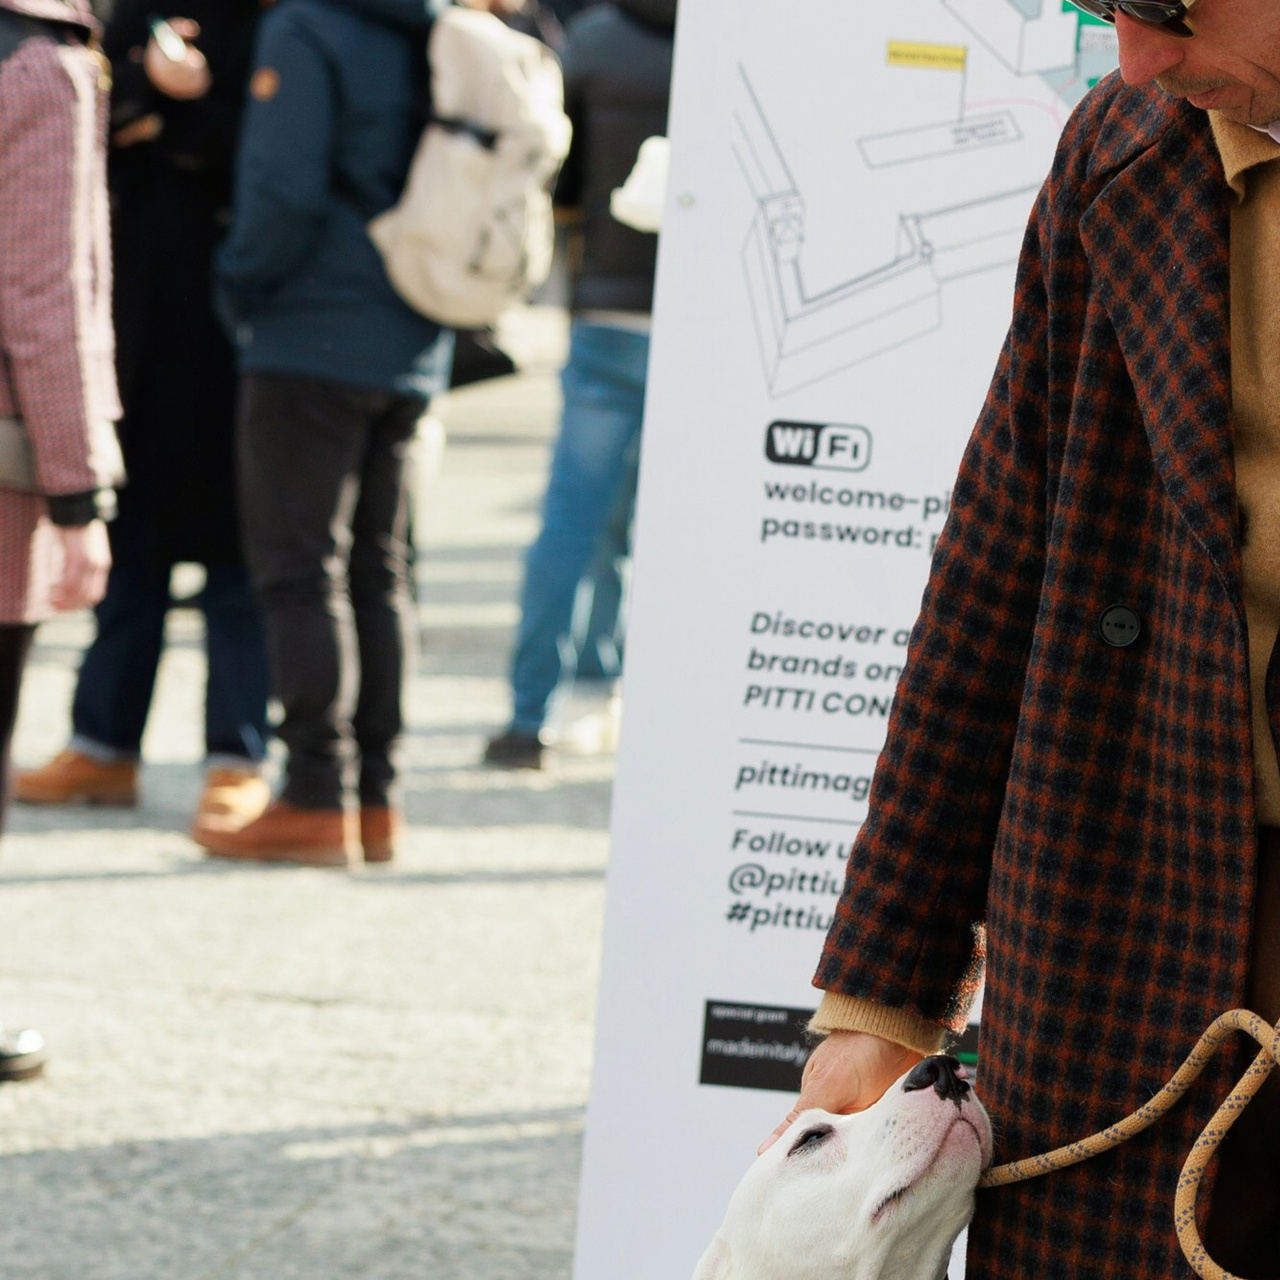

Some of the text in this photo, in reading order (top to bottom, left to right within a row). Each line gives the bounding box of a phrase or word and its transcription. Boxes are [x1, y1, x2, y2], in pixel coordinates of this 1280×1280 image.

[761, 518, 921, 549] password:
[750, 610, 887, 646] Discover
[747, 648, 858, 680] brands
[743, 684, 890, 718] PITTI CON
[734, 760, 871, 802] pittimag
[731, 828, 832, 858] Follow
